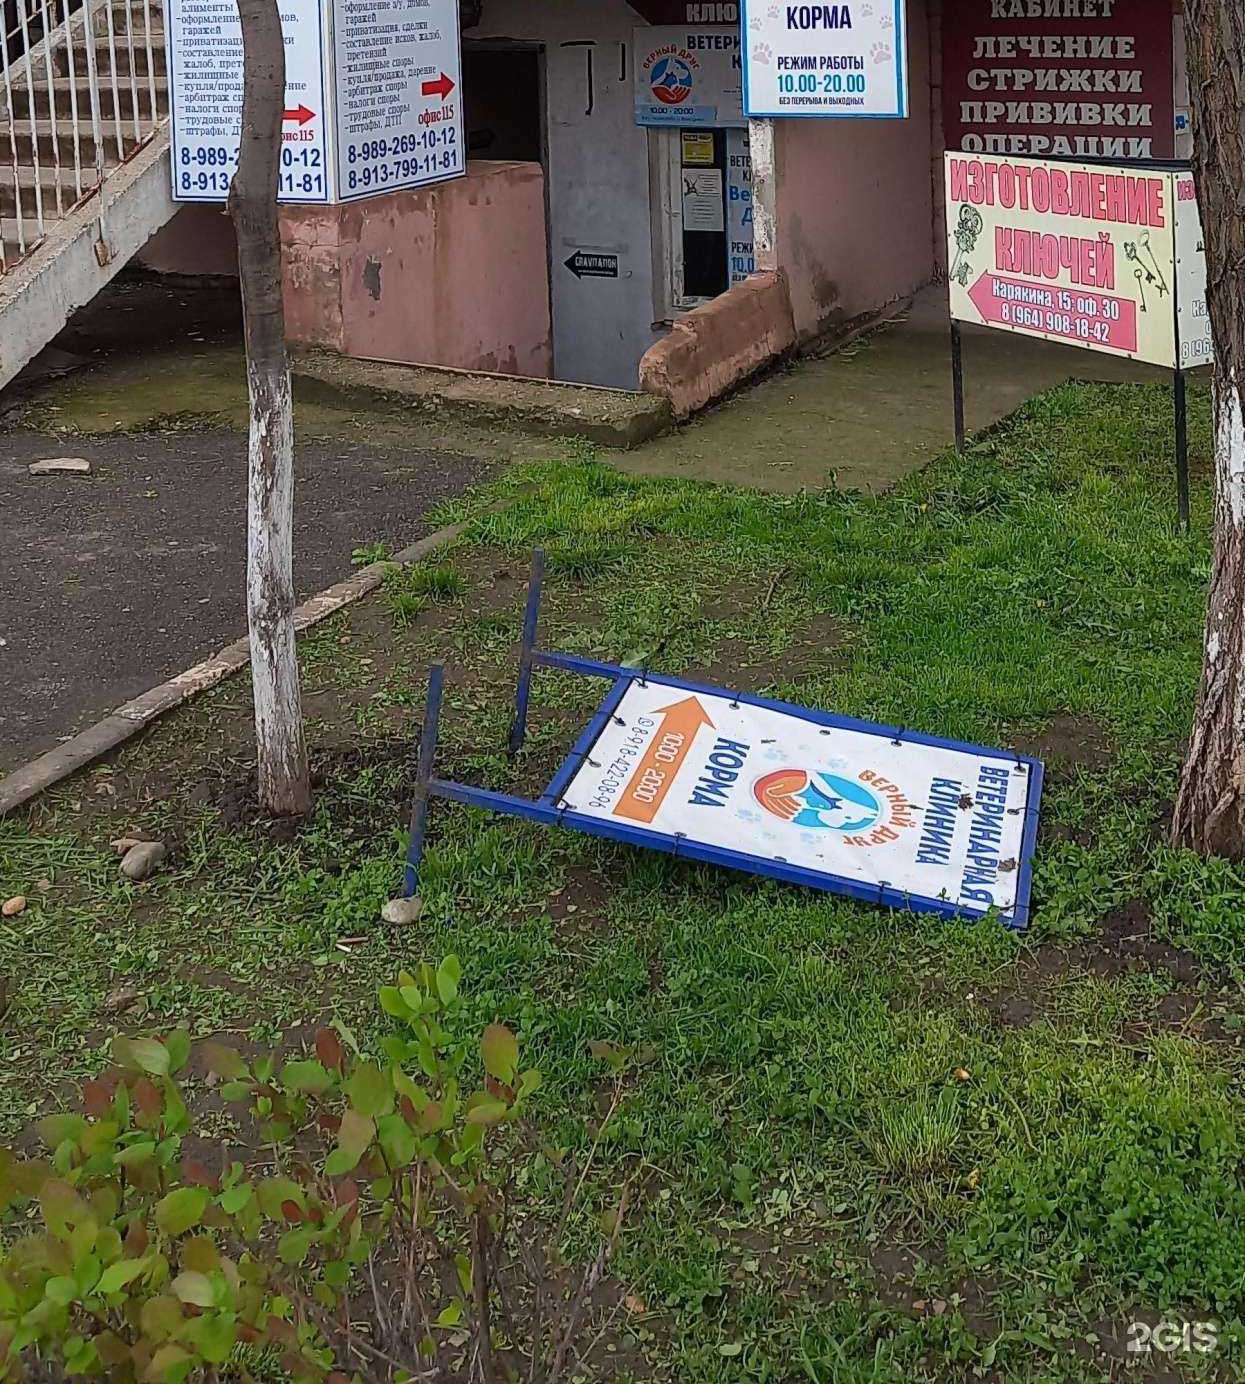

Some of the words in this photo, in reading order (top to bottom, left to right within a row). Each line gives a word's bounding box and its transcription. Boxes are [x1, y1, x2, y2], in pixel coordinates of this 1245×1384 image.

[181, 4, 234, 13] алименты
[686, 3, 738, 22] КЛЮ
[786, 5, 852, 29] КОРМА
[182, 25, 222, 36] гаражей
[972, 36, 1135, 59] ЛЕЧЕНИЕ
[777, 56, 817, 70] РЕЖИМ
[820, 56, 864, 70] РАБОТЫ
[777, 74, 866, 93] 10.00-20.00
[967, 68, 1142, 93] СТРИЖКИ
[959, 101, 1152, 127] ПРИВИВКИ
[348, 126, 456, 163] 8-989-269-10-12
[960, 133, 1153, 158] ОПЕРАЦИИ
[348, 149, 457, 189] 8-913-799-11-81
[950, 157, 1165, 228] ИЗГОТОВЛЕНИЕ
[994, 226, 1115, 290] КЛЮЧЕЙ
[1002, 303, 1009, 321] 8
[1012, 304, 1043, 331] (964)
[1046, 315, 1110, 343] 908-18-42
[1102, 301, 1119, 320] 30
[688, 737, 750, 807] КОРМА
[858, 769, 917, 828] ВЕРНЫЙ
[915, 777, 962, 865] КЛИНИКА
[843, 825, 900, 847] ДРУГ
[960, 765, 1009, 908] ВЕТЕРИНАРНАЯ
